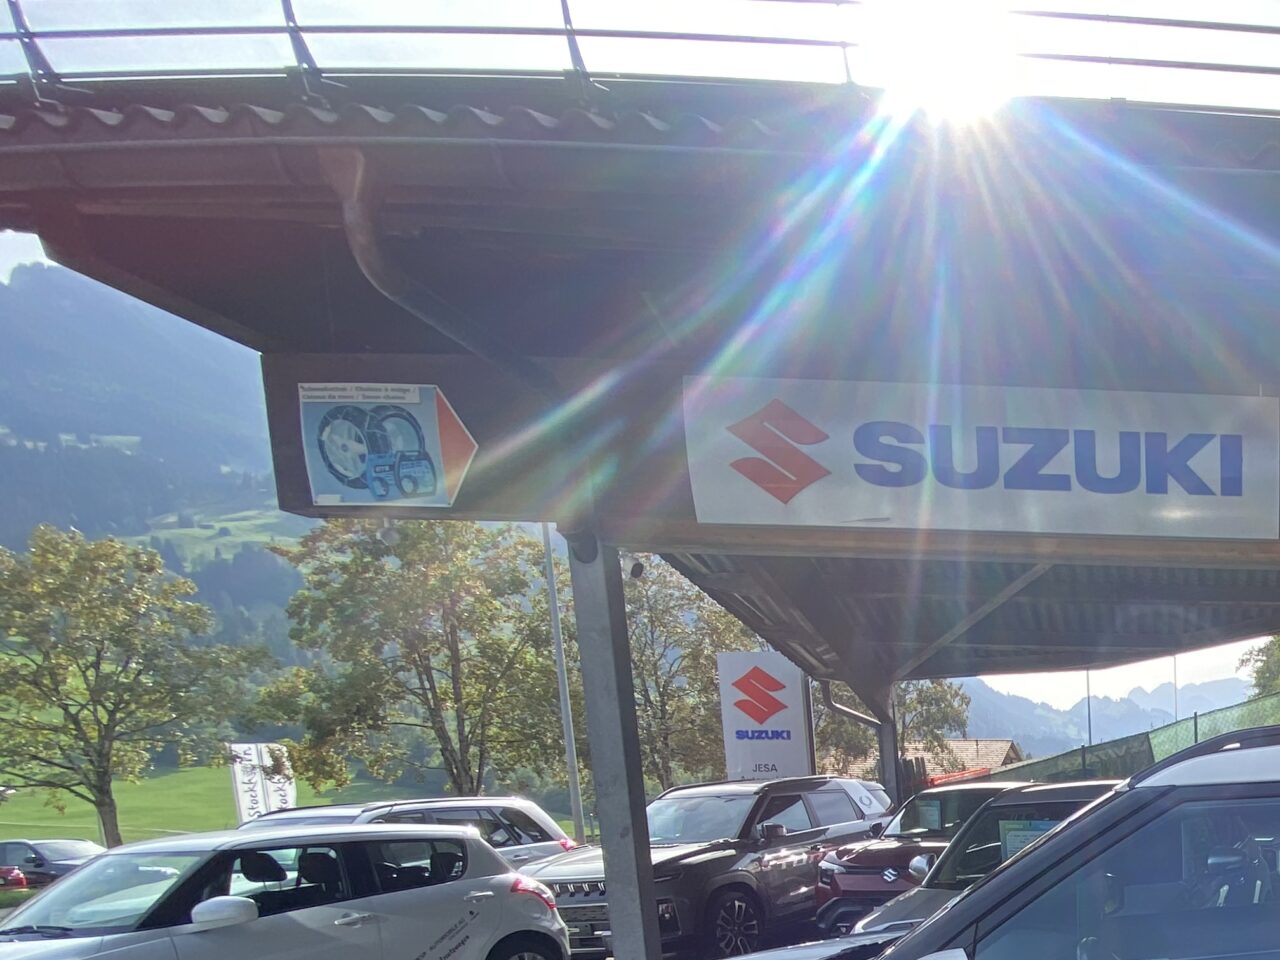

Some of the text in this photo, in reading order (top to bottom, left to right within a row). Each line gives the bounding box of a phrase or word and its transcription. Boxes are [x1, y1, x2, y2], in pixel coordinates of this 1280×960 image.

[853, 420, 1243, 497] SUZUKI
[735, 730, 791, 741] SUZUKI
[752, 763, 778, 773] JESA
